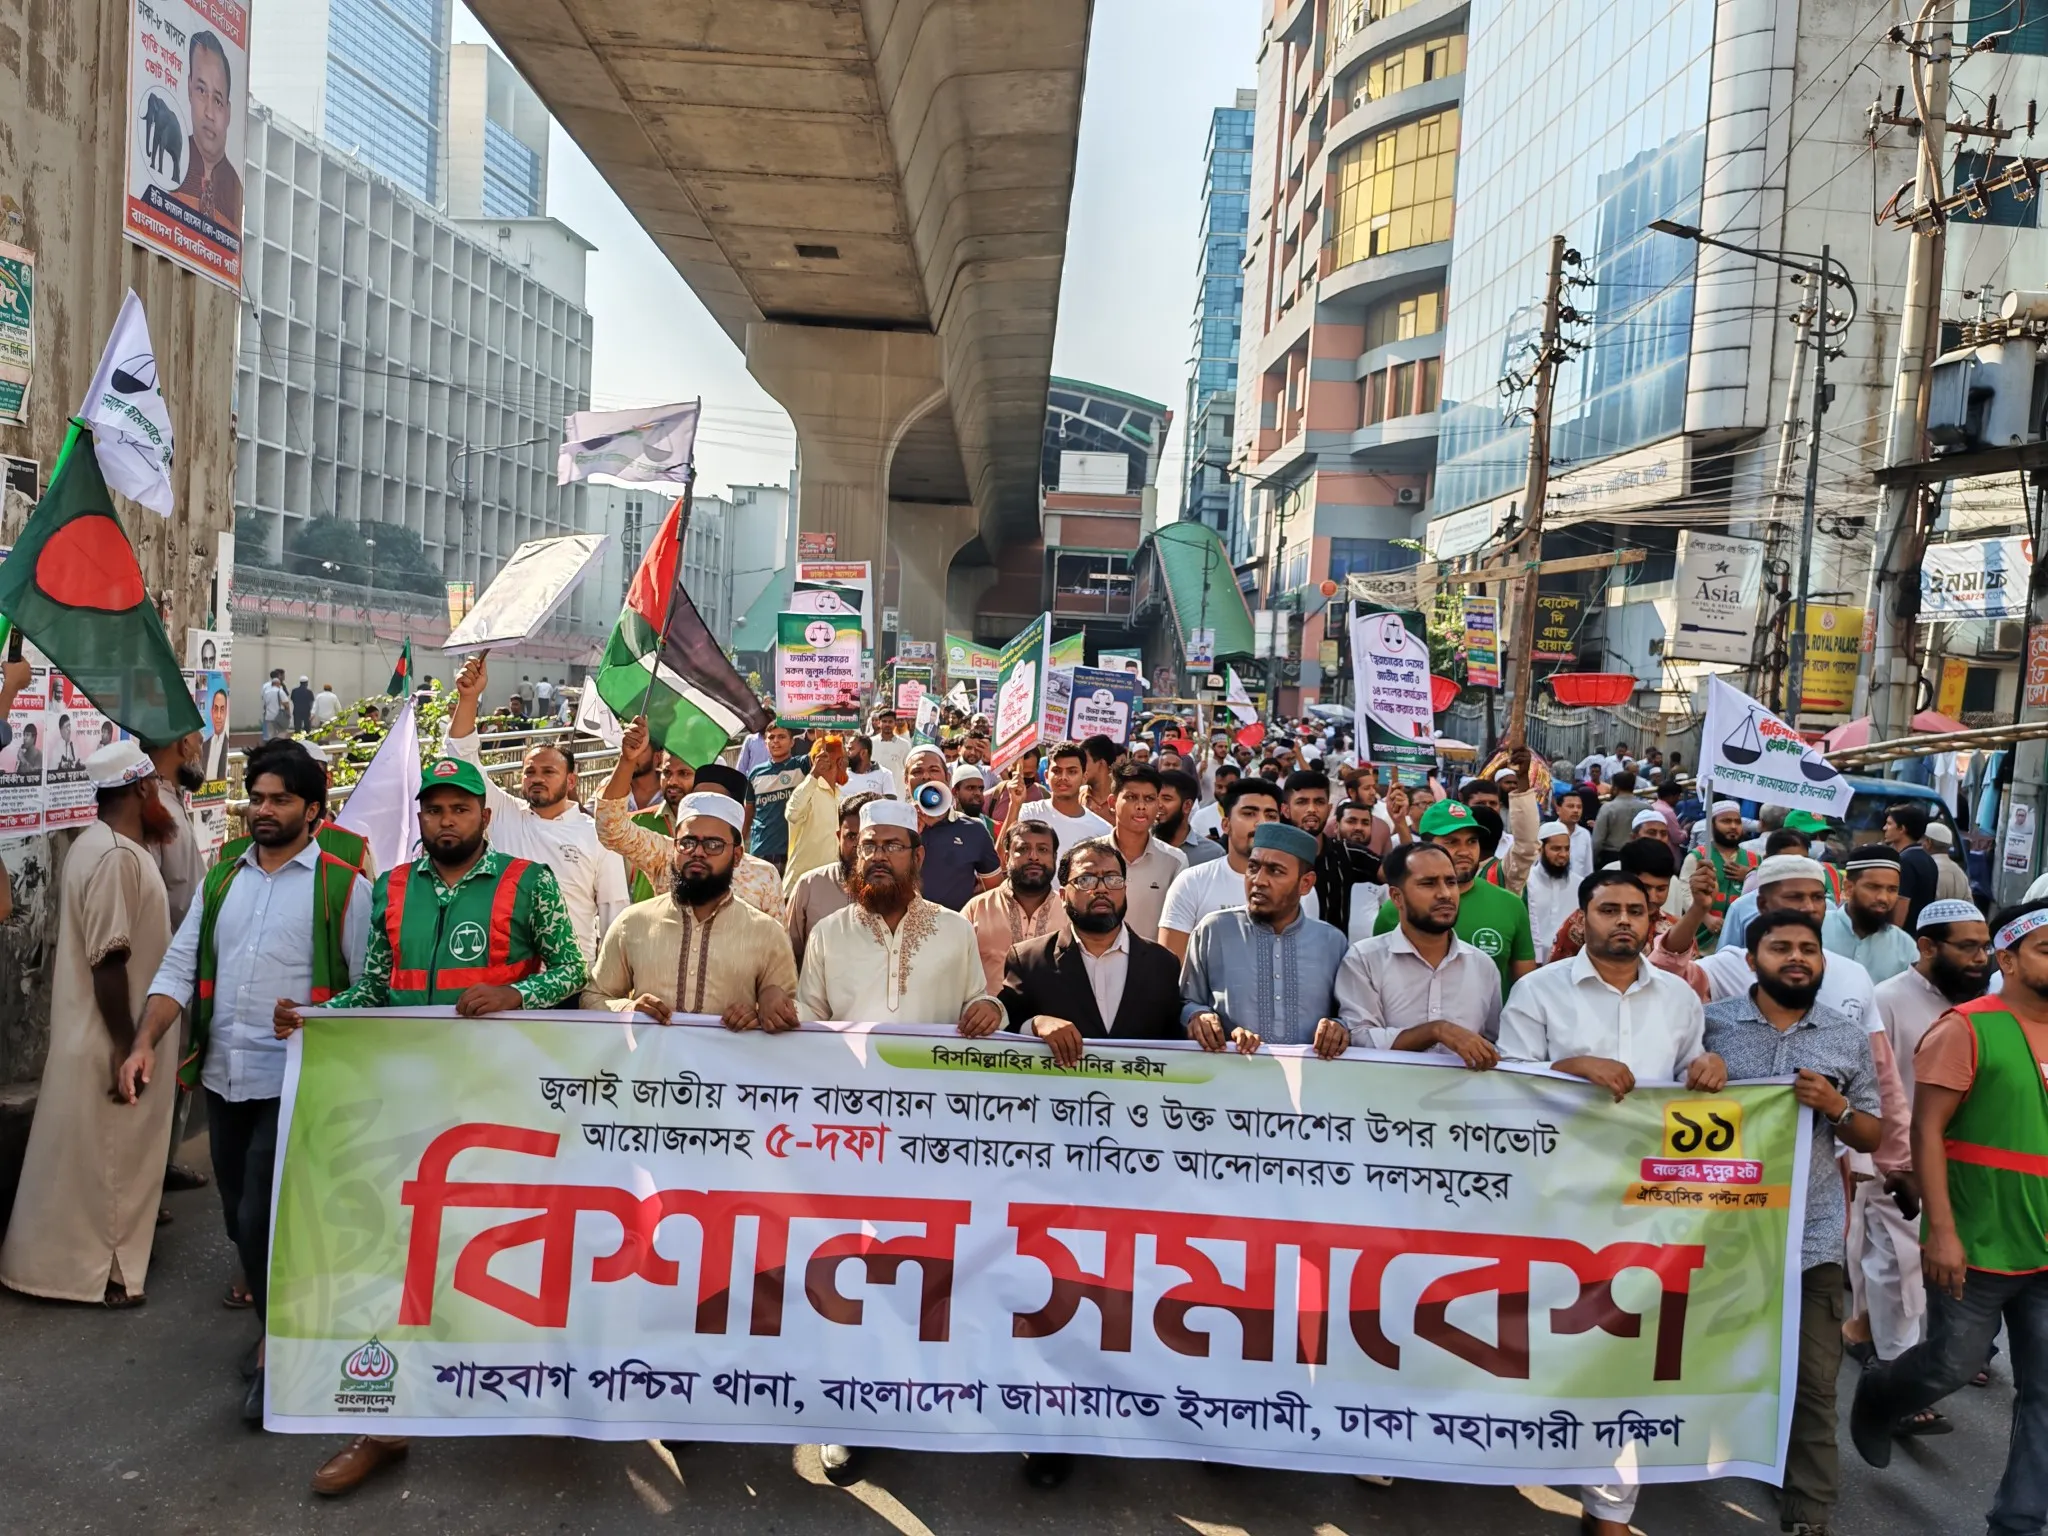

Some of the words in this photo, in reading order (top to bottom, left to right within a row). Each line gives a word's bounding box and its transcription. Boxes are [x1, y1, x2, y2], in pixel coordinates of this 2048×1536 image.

[131, 207, 172, 240] বাংলাদেশ
[1695, 582, 1741, 603] Asia
[1538, 596, 1580, 611] হোটেল
[1550, 610, 1565, 625] দি
[1812, 634, 1832, 652] ROYAL
[1834, 635, 1859, 654] PALACE
[818, 654, 849, 664] সরকারের
[1405, 659, 1424, 670] দোসর
[785, 667, 803, 675] সকল
[1376, 669, 1399, 682] জাতীয়
[1382, 687, 1402, 698] দলের
[1396, 704, 1414, 715] করতে
[1714, 764, 1754, 784] বাংলাদেশ
[1756, 774, 1798, 793] জামায়াতে
[1800, 781, 1836, 801] ইসলামী
[931, 1045, 1035, 1070] বিসমিল্লাহির
[1040, 1054, 1116, 1074] রহানির
[1120, 1056, 1167, 1077] রহীম
[539, 1070, 622, 1111] জুলাই
[632, 1071, 727, 1110] জাতীয়
[736, 1083, 803, 1114] সনদ
[812, 1086, 937, 1119] বাস্তবায়ন
[946, 1092, 1038, 1124] আদেশ
[1050, 1091, 1116, 1128] জারি
[1127, 1107, 1148, 1128] ও
[1160, 1094, 1216, 1132] উক্ত
[1226, 1107, 1356, 1144] আদেশের
[1367, 1111, 1437, 1148] উপর
[1449, 1121, 1560, 1158] গণভোট
[1671, 1111, 1735, 1153] ১১
[582, 1121, 755, 1160] আয়োজনসহ
[766, 1121, 892, 1164] ৫-দফা
[900, 1134, 1050, 1170] বাস্তবায়নের
[1064, 1136, 1165, 1176] দাবিতে
[1173, 1149, 1355, 1188] আন্দোলনরত
[1363, 1162, 1511, 1208] দলসমূহের
[1702, 1164, 1735, 1182] দুপুর
[1737, 1163, 1758, 1178] ২টা
[1636, 1186, 1703, 1205] ঐতিহাসিক
[1708, 1188, 1740, 1207] পল্টন
[1743, 1191, 1769, 1208] মোড়
[398, 1122, 972, 1343] বিশাল
[1007, 1201, 1706, 1381] সমাবেশ
[334, 1394, 396, 1405] বাংলাদেশ
[432, 1361, 577, 1402] শাহবাগ
[588, 1359, 700, 1403] পশ্চিম
[712, 1371, 805, 1415] থানা,
[822, 1376, 988, 1416] বাংলাদেশ
[998, 1382, 1165, 1420] জামায়াতে
[1174, 1385, 1322, 1441] ইসলামী,
[1335, 1405, 1419, 1442] ঢাকা
[1432, 1409, 1582, 1452] মহানগরী
[1593, 1409, 1686, 1450] দক্ষিণ
